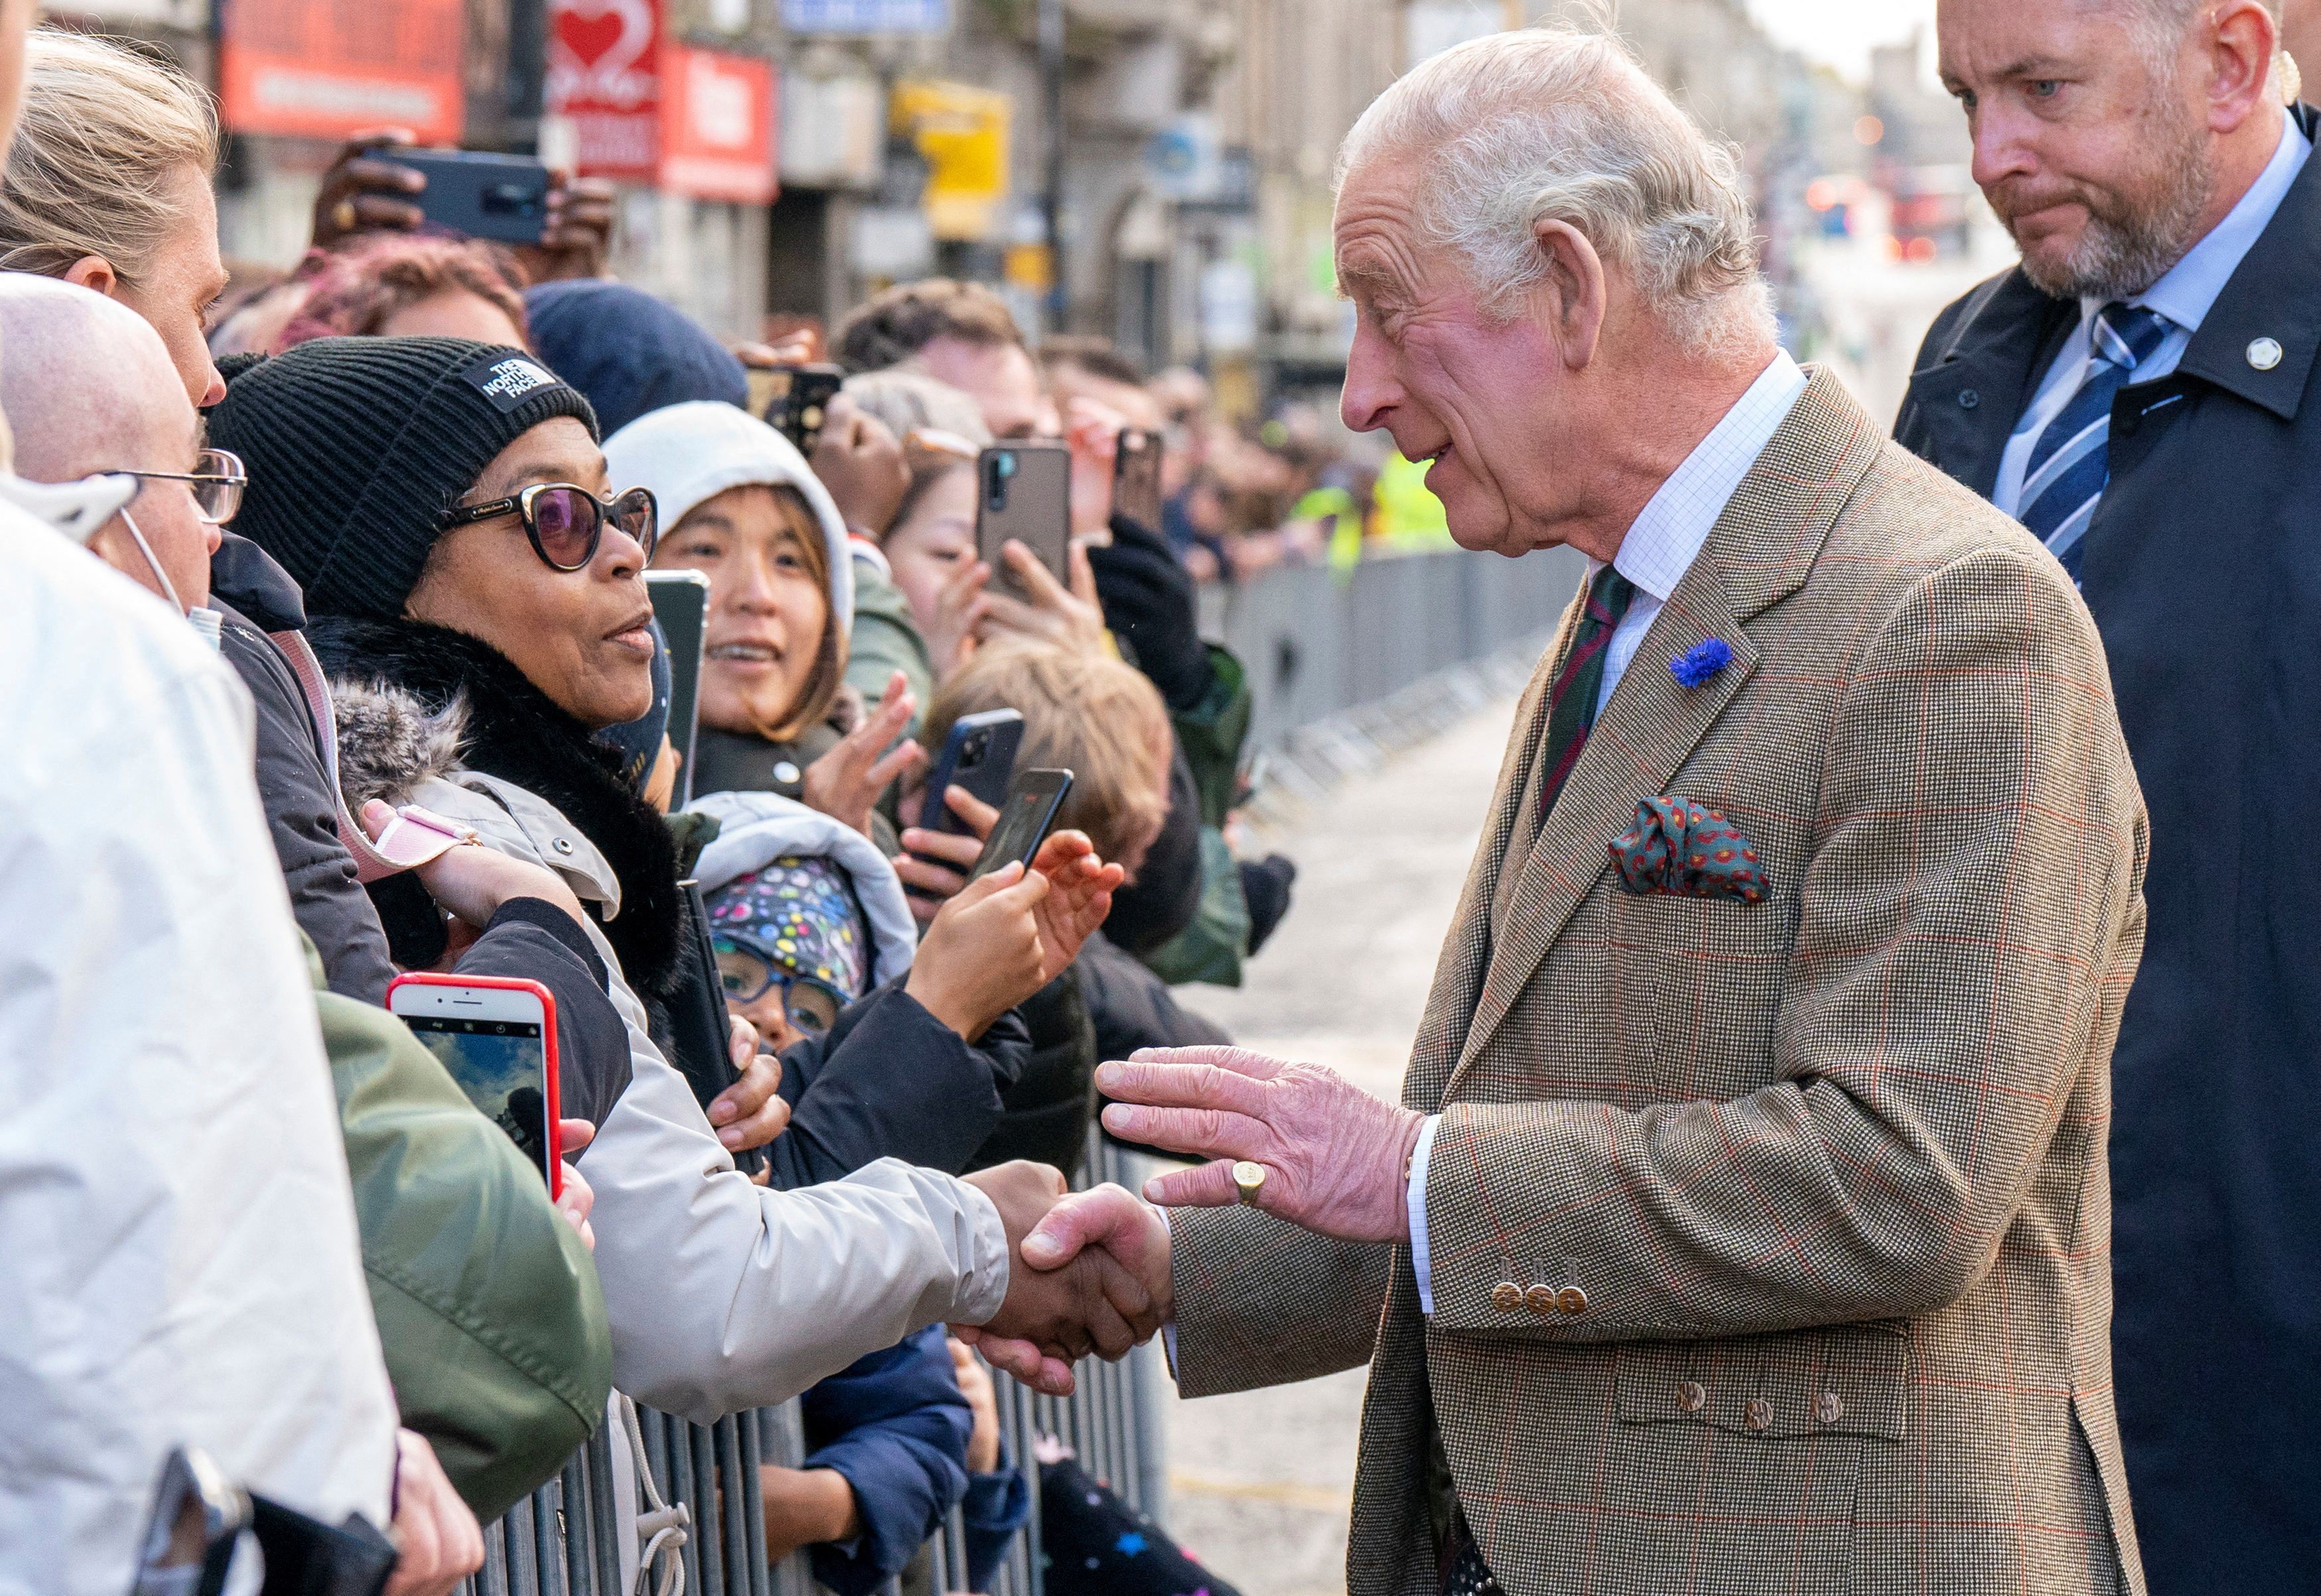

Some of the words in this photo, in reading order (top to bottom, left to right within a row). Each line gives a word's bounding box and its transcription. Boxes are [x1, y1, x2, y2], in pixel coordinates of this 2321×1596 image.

[489, 359, 519, 375] THE
[482, 367, 529, 397] NORTH
[505, 376, 540, 399] FACE
